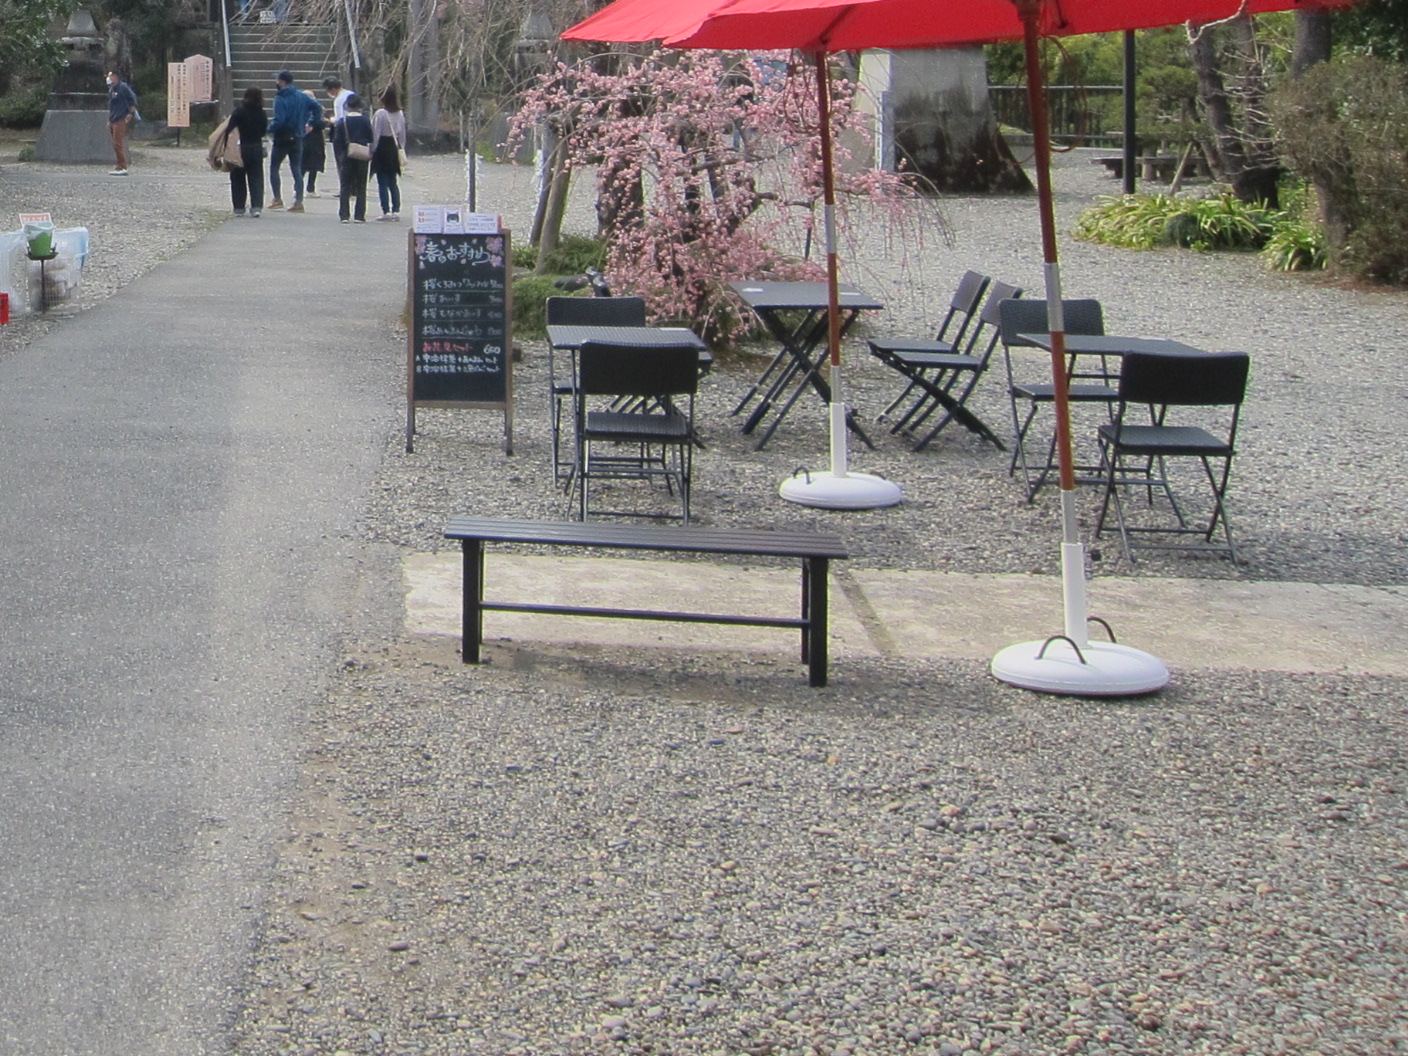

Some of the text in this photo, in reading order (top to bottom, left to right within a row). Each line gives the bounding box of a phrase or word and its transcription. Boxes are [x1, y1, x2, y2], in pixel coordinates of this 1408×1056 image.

[419, 241, 492, 267] 春のおすすめ
